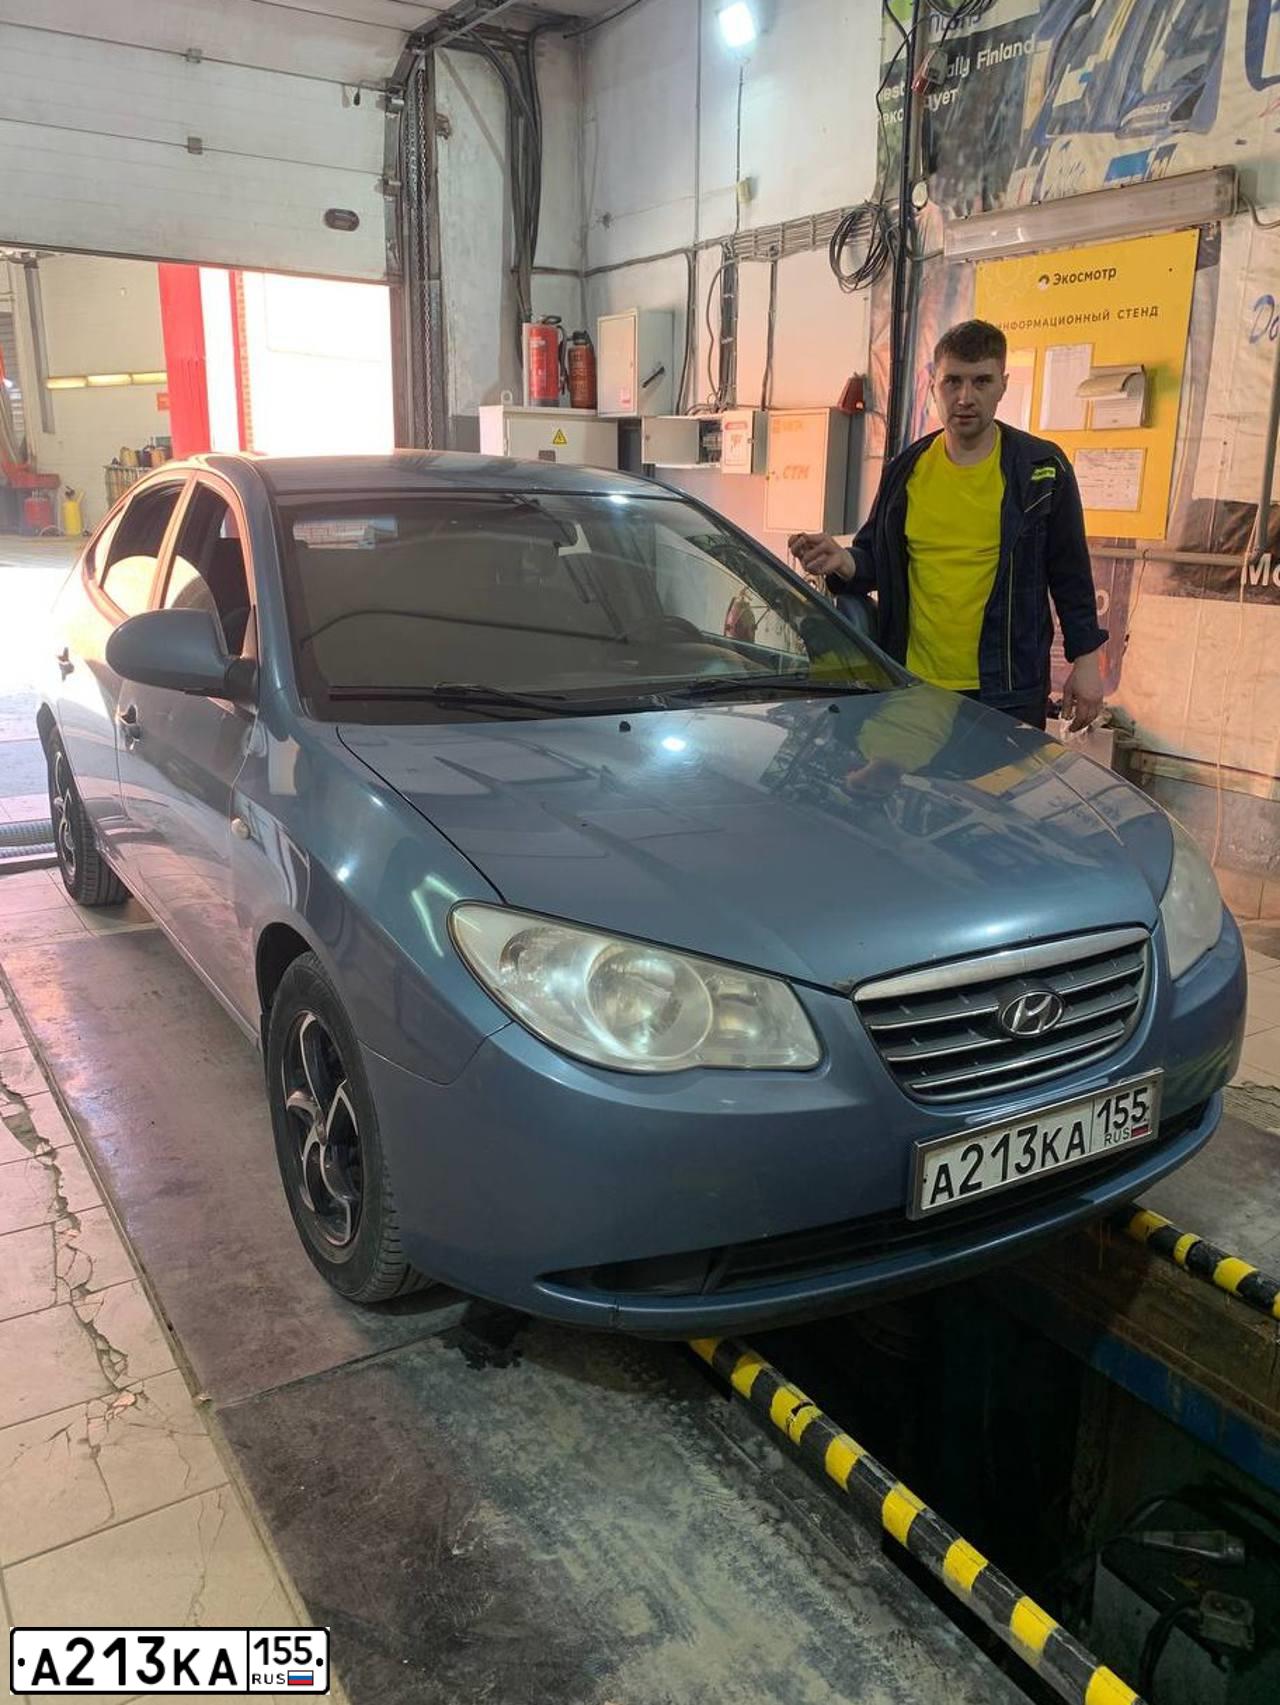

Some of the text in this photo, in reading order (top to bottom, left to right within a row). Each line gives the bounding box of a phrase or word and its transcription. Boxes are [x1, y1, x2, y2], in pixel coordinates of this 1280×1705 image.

[977, 33, 1035, 70] Finland
[1053, 267, 1117, 286] Экосмотр
[1117, 305, 1159, 320] СТЕНД
[930, 1087, 1148, 1205] А213КА 155
[1104, 1127, 1130, 1147] RUS
